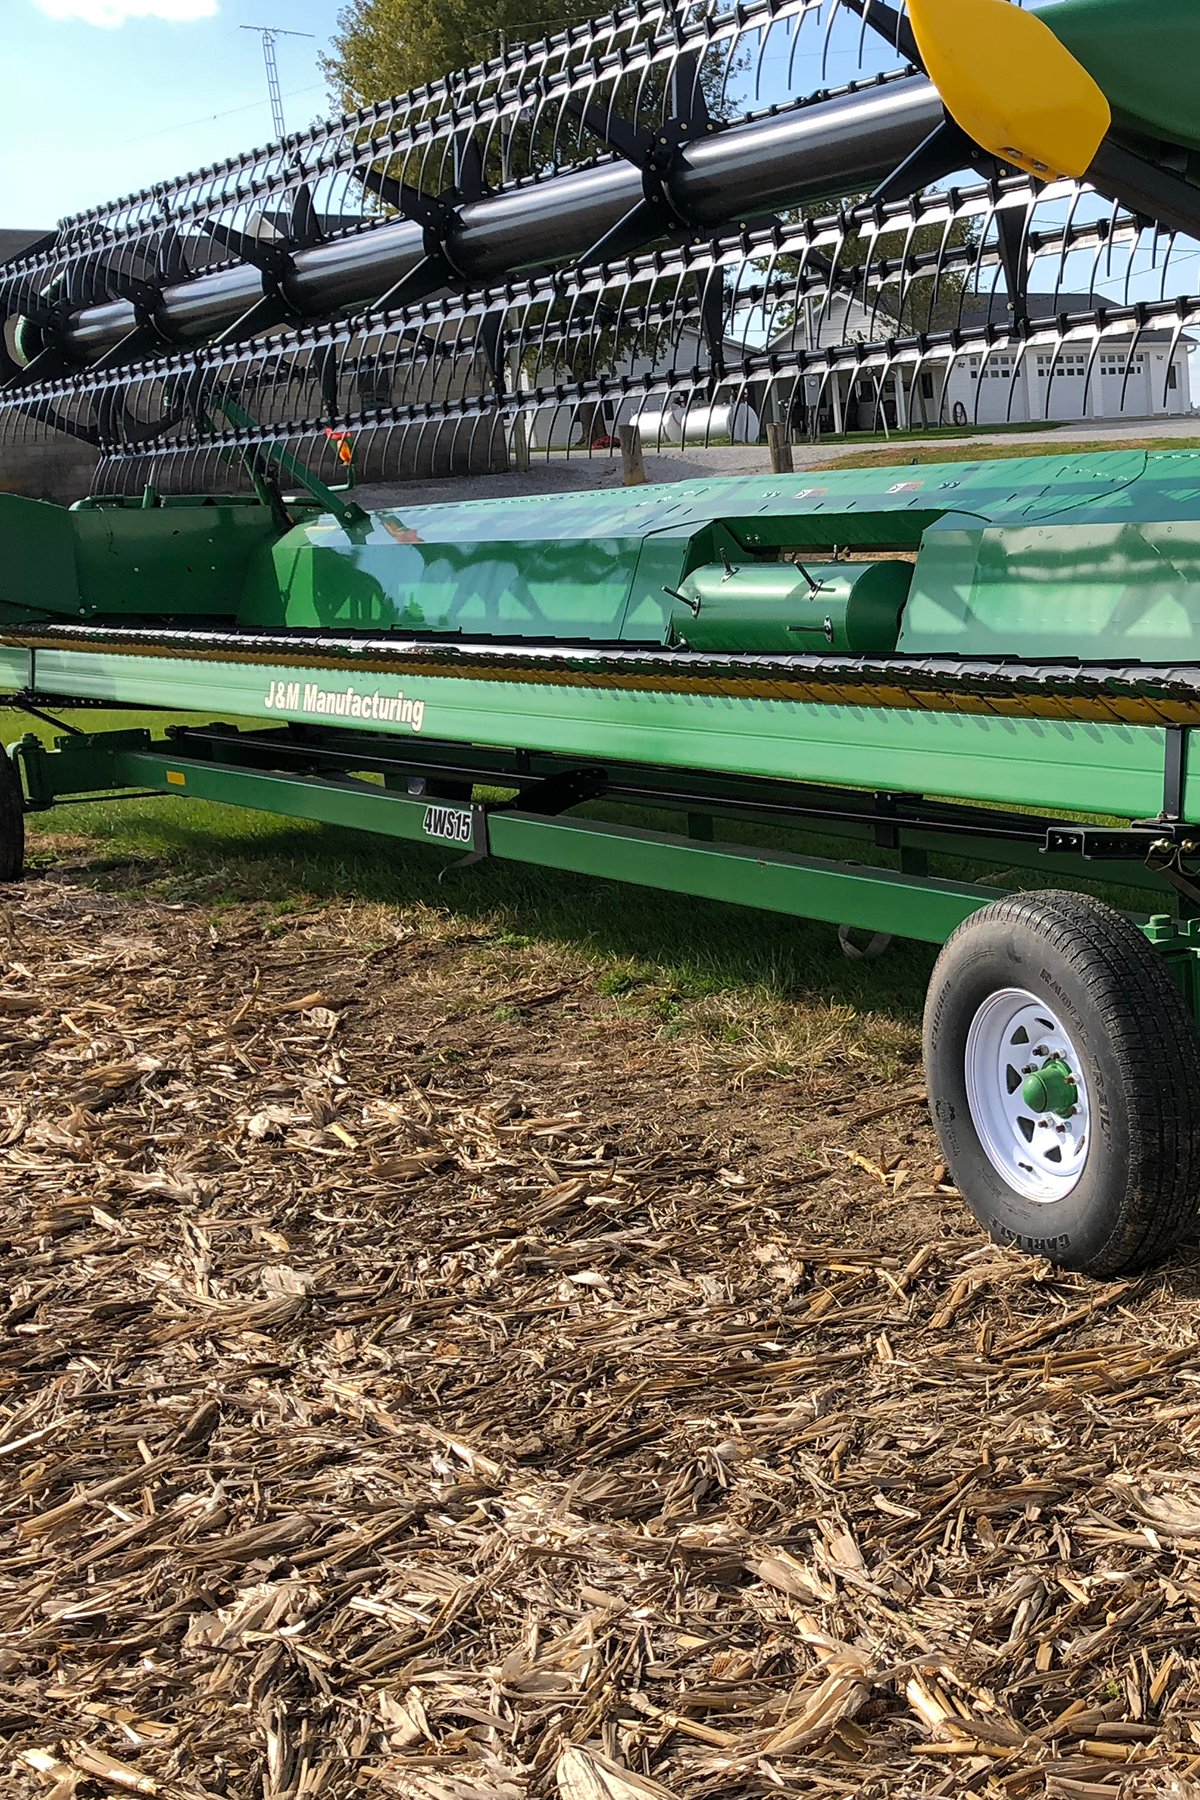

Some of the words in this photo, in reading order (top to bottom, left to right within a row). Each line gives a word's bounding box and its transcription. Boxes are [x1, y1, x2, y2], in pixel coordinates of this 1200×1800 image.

[265, 681, 300, 710] J&M
[303, 683, 425, 732] Manufacturing
[423, 807, 471, 842] 4WS15
[1039, 968, 1090, 1046] RADIAL
[989, 1213, 1071, 1251] CARLISLE
